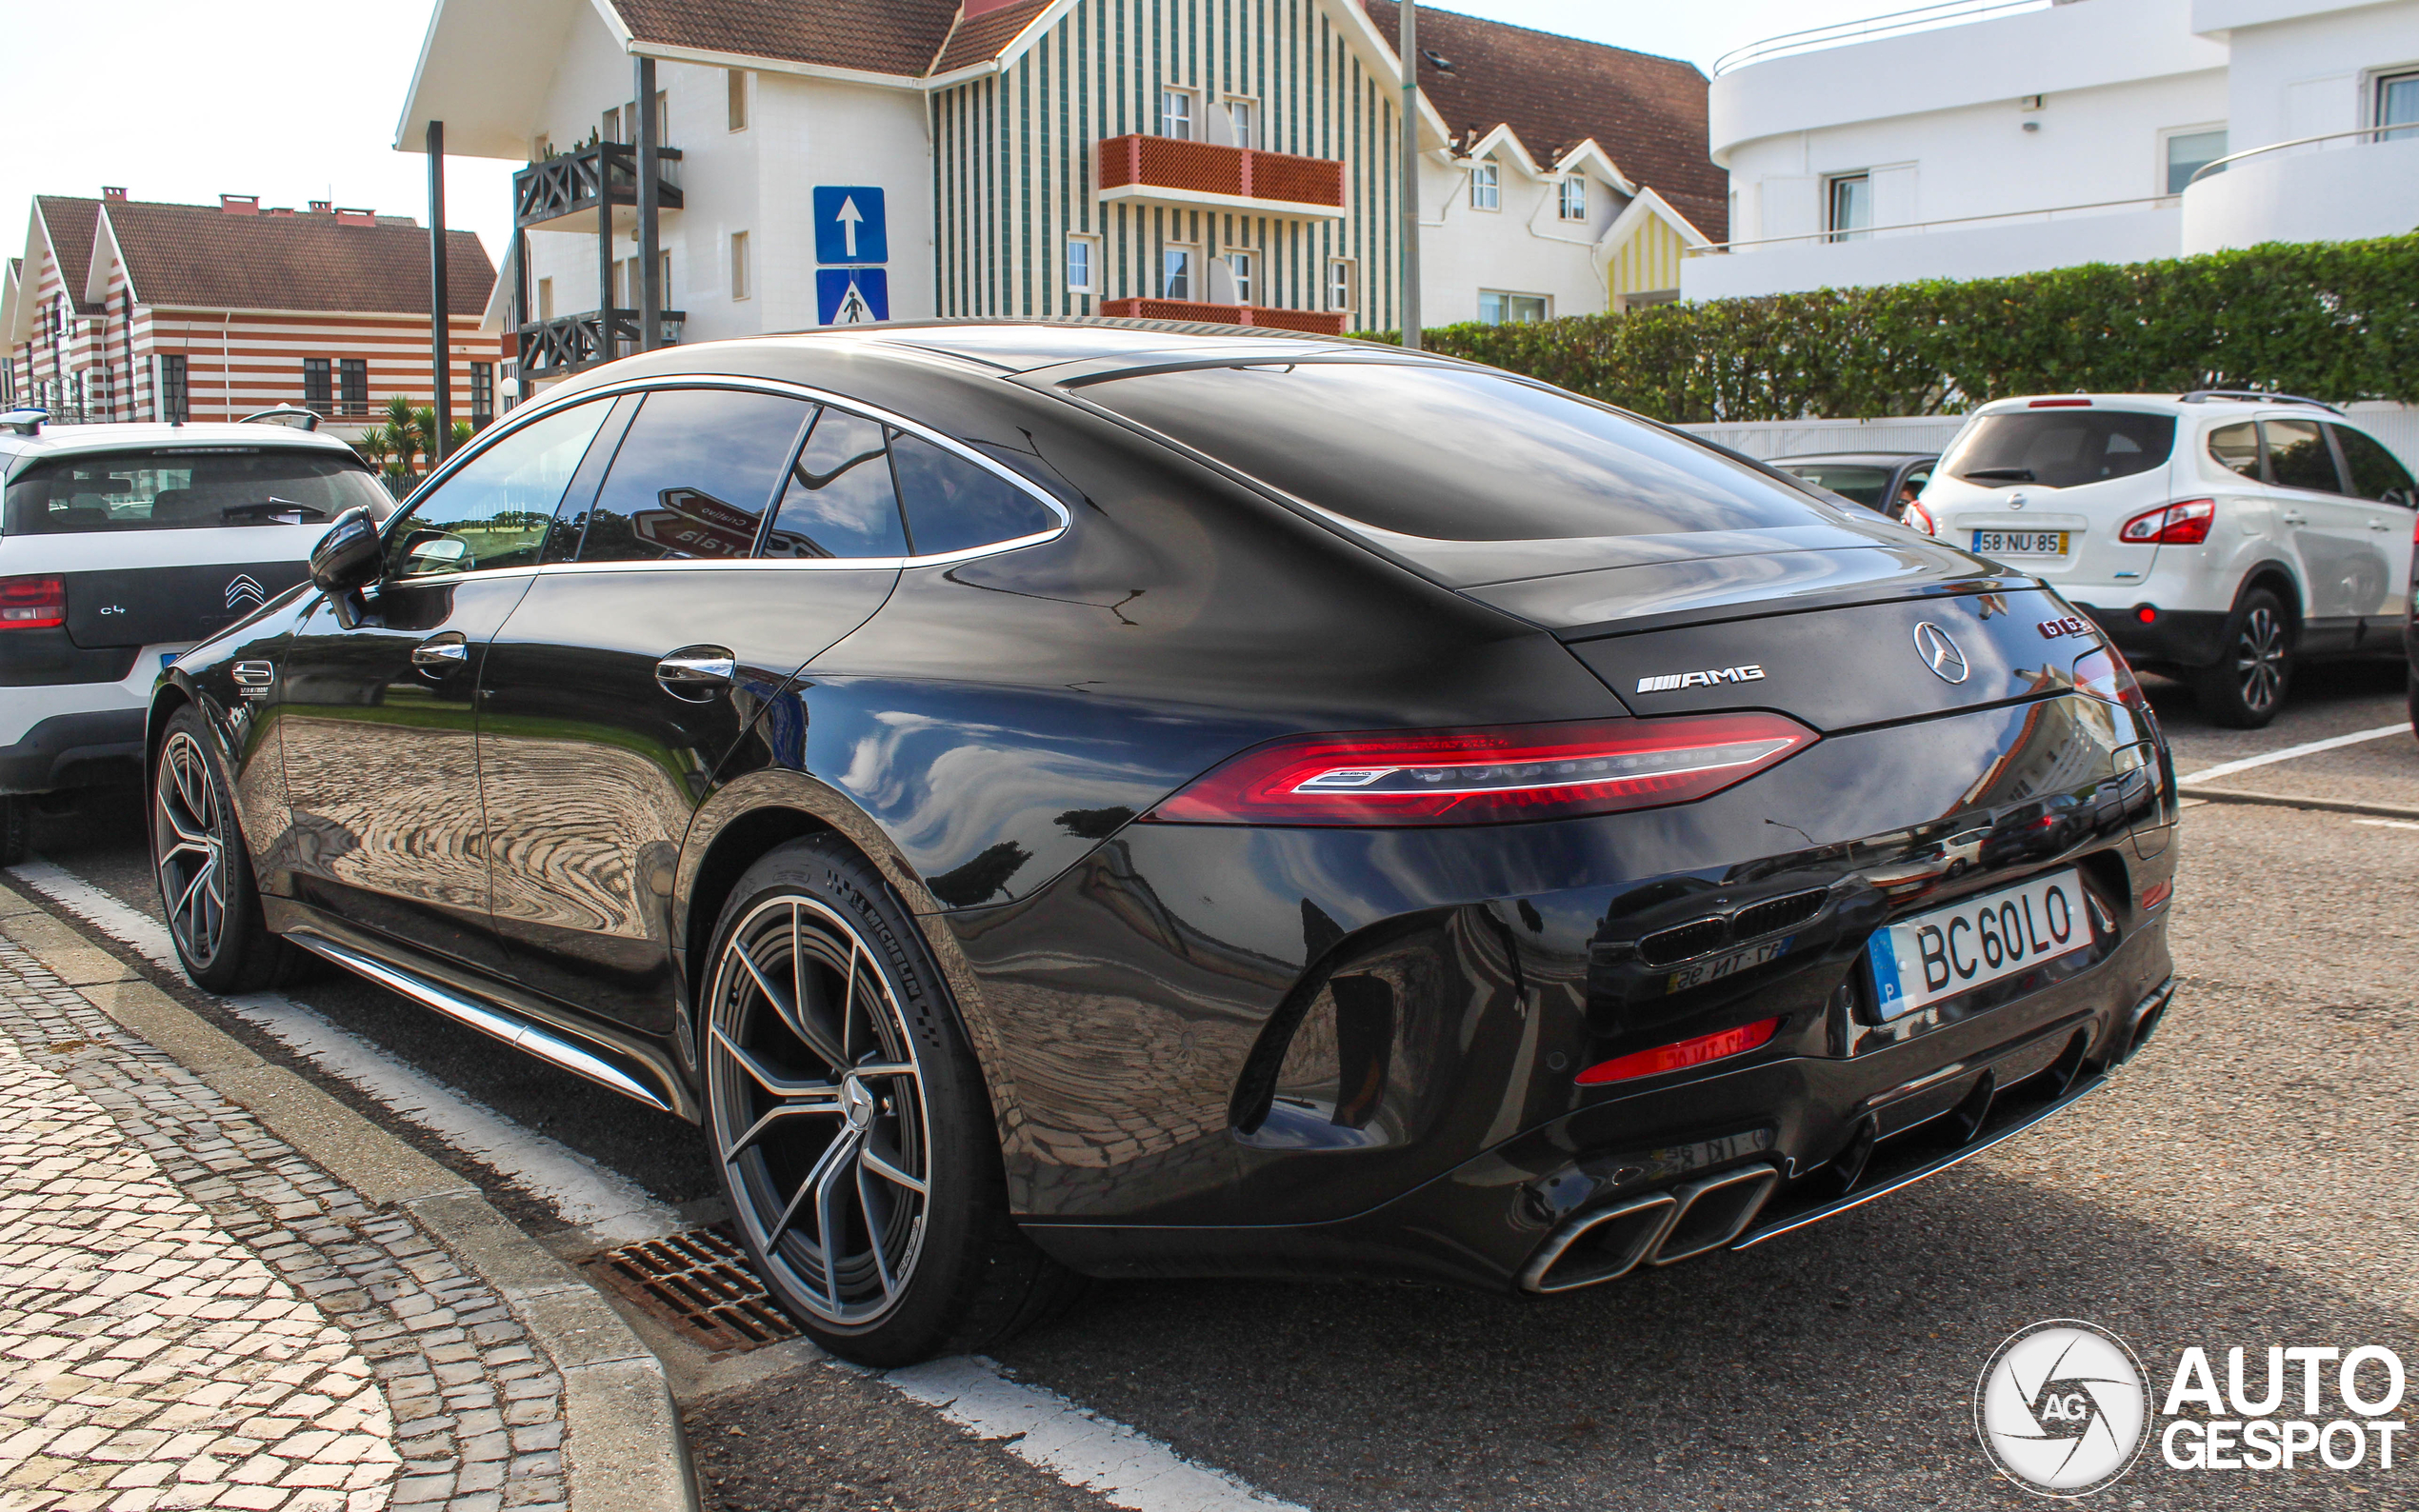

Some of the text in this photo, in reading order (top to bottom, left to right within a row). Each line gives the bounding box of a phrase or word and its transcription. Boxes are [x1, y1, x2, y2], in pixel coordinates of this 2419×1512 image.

[1680, 665, 1766, 688] AMG
[864, 906, 921, 997] MICHELIN
[1917, 885, 2071, 993] BC60LO
[1884, 983, 1894, 1002] P
